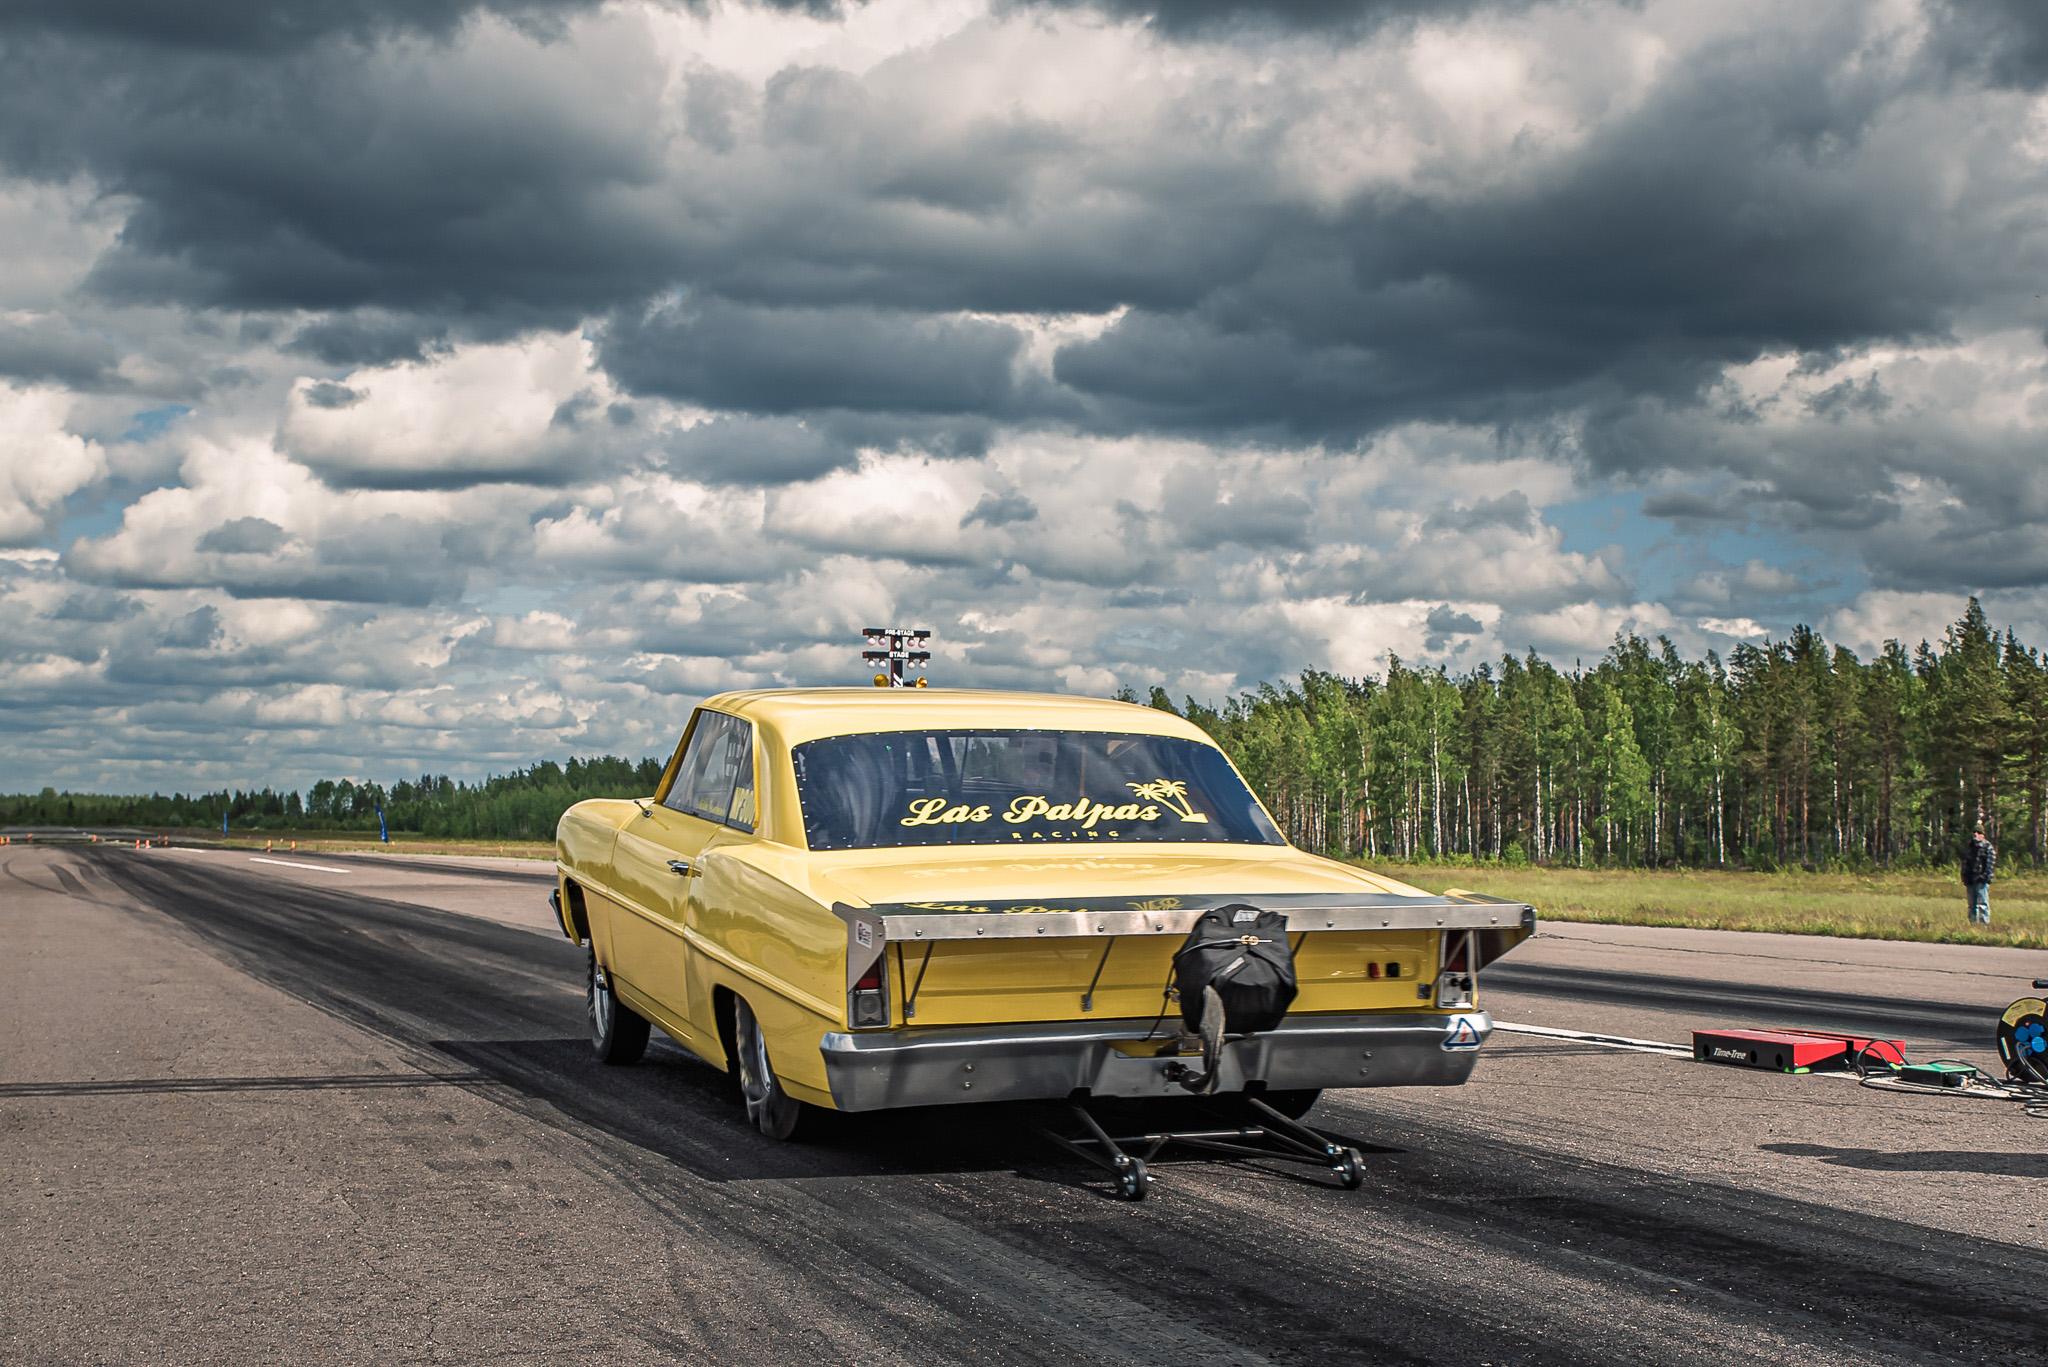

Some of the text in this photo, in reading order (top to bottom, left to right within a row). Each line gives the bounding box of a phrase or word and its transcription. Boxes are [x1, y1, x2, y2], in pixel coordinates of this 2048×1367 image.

[900, 796, 1161, 829] Las Palpas
[1012, 830, 1120, 839] RACING
[1713, 1047, 1747, 1059] Time-Tree
